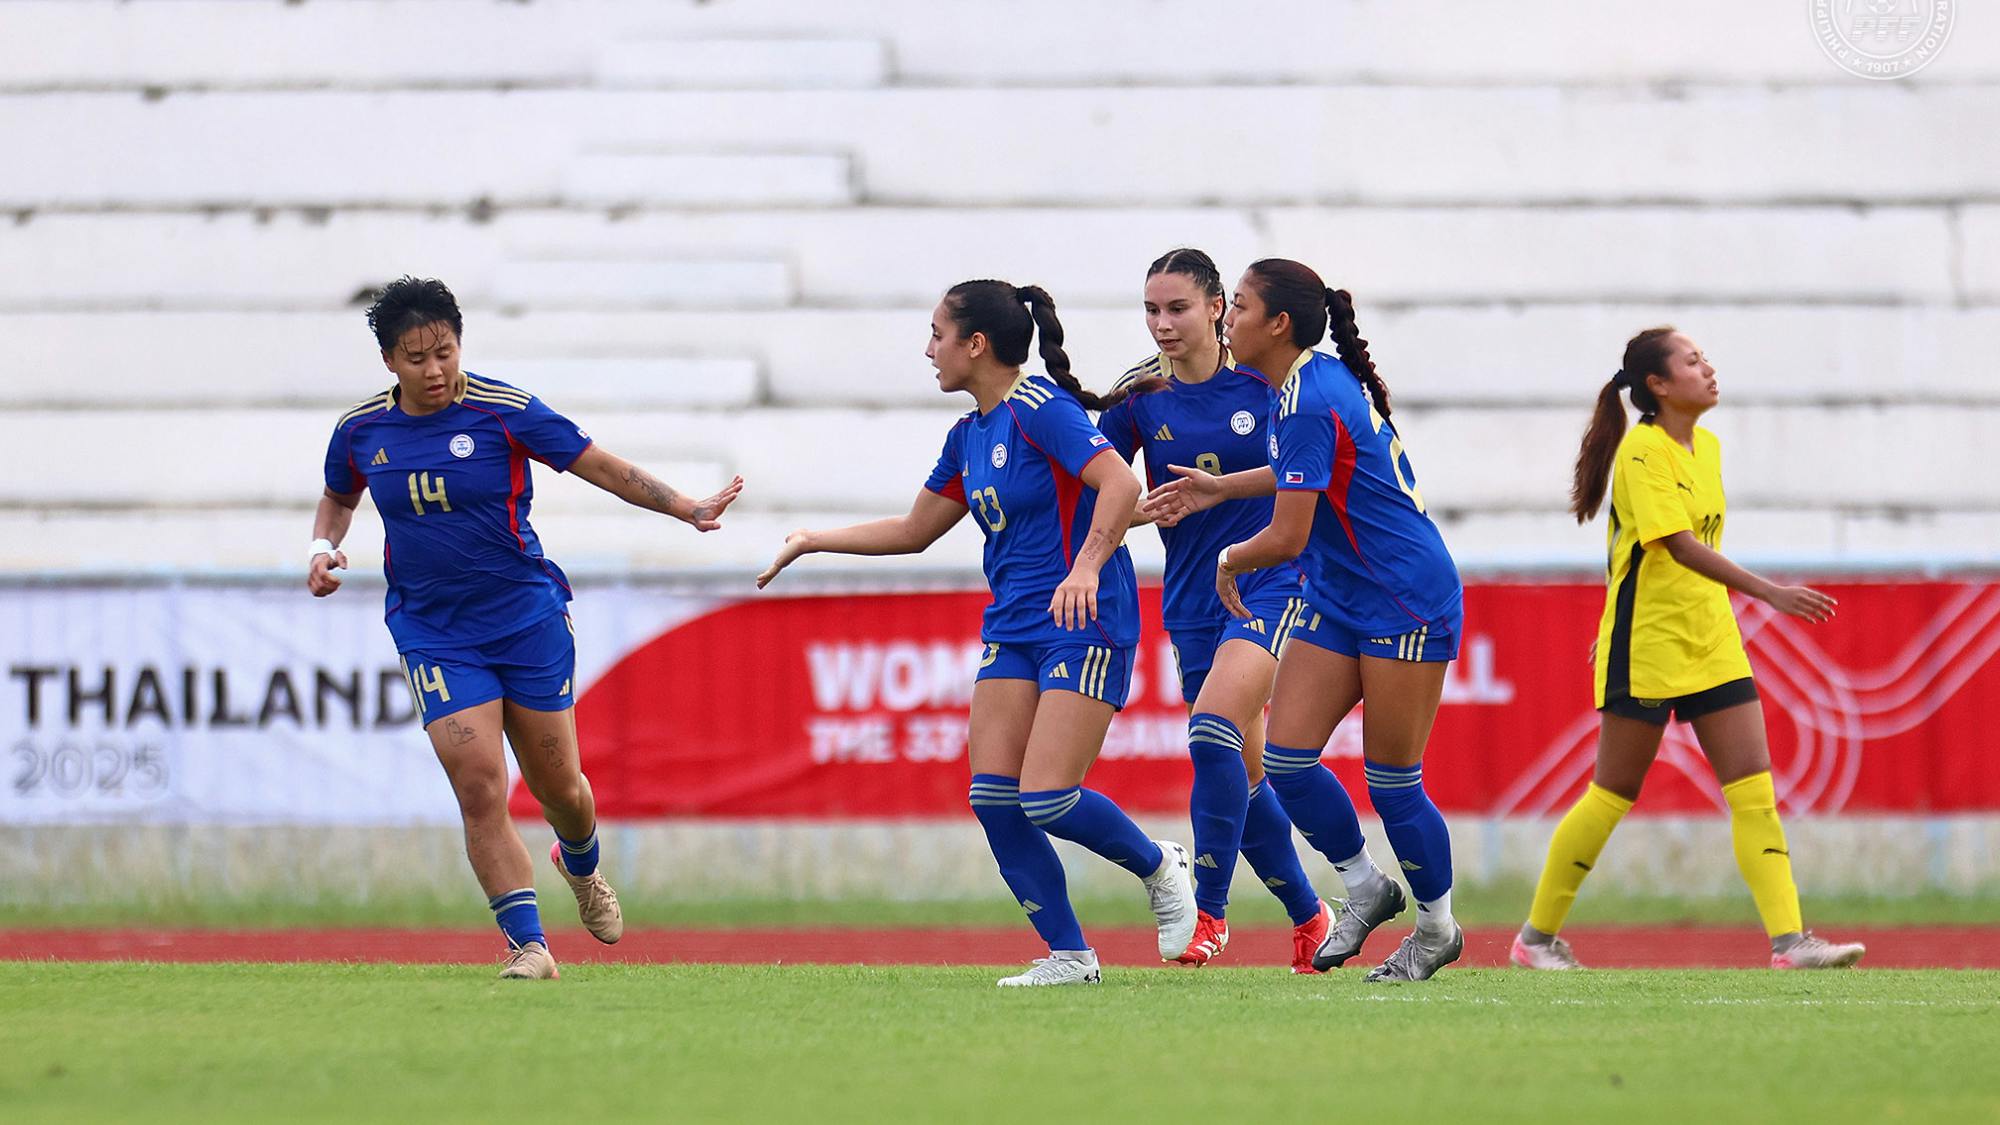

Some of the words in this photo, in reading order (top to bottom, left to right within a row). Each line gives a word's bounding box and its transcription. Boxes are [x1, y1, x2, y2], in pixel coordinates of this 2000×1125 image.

[408, 471, 452, 516] 14
[10, 666, 417, 729] THAILAND
[413, 663, 451, 713] 14
[11, 741, 169, 800] 2025
